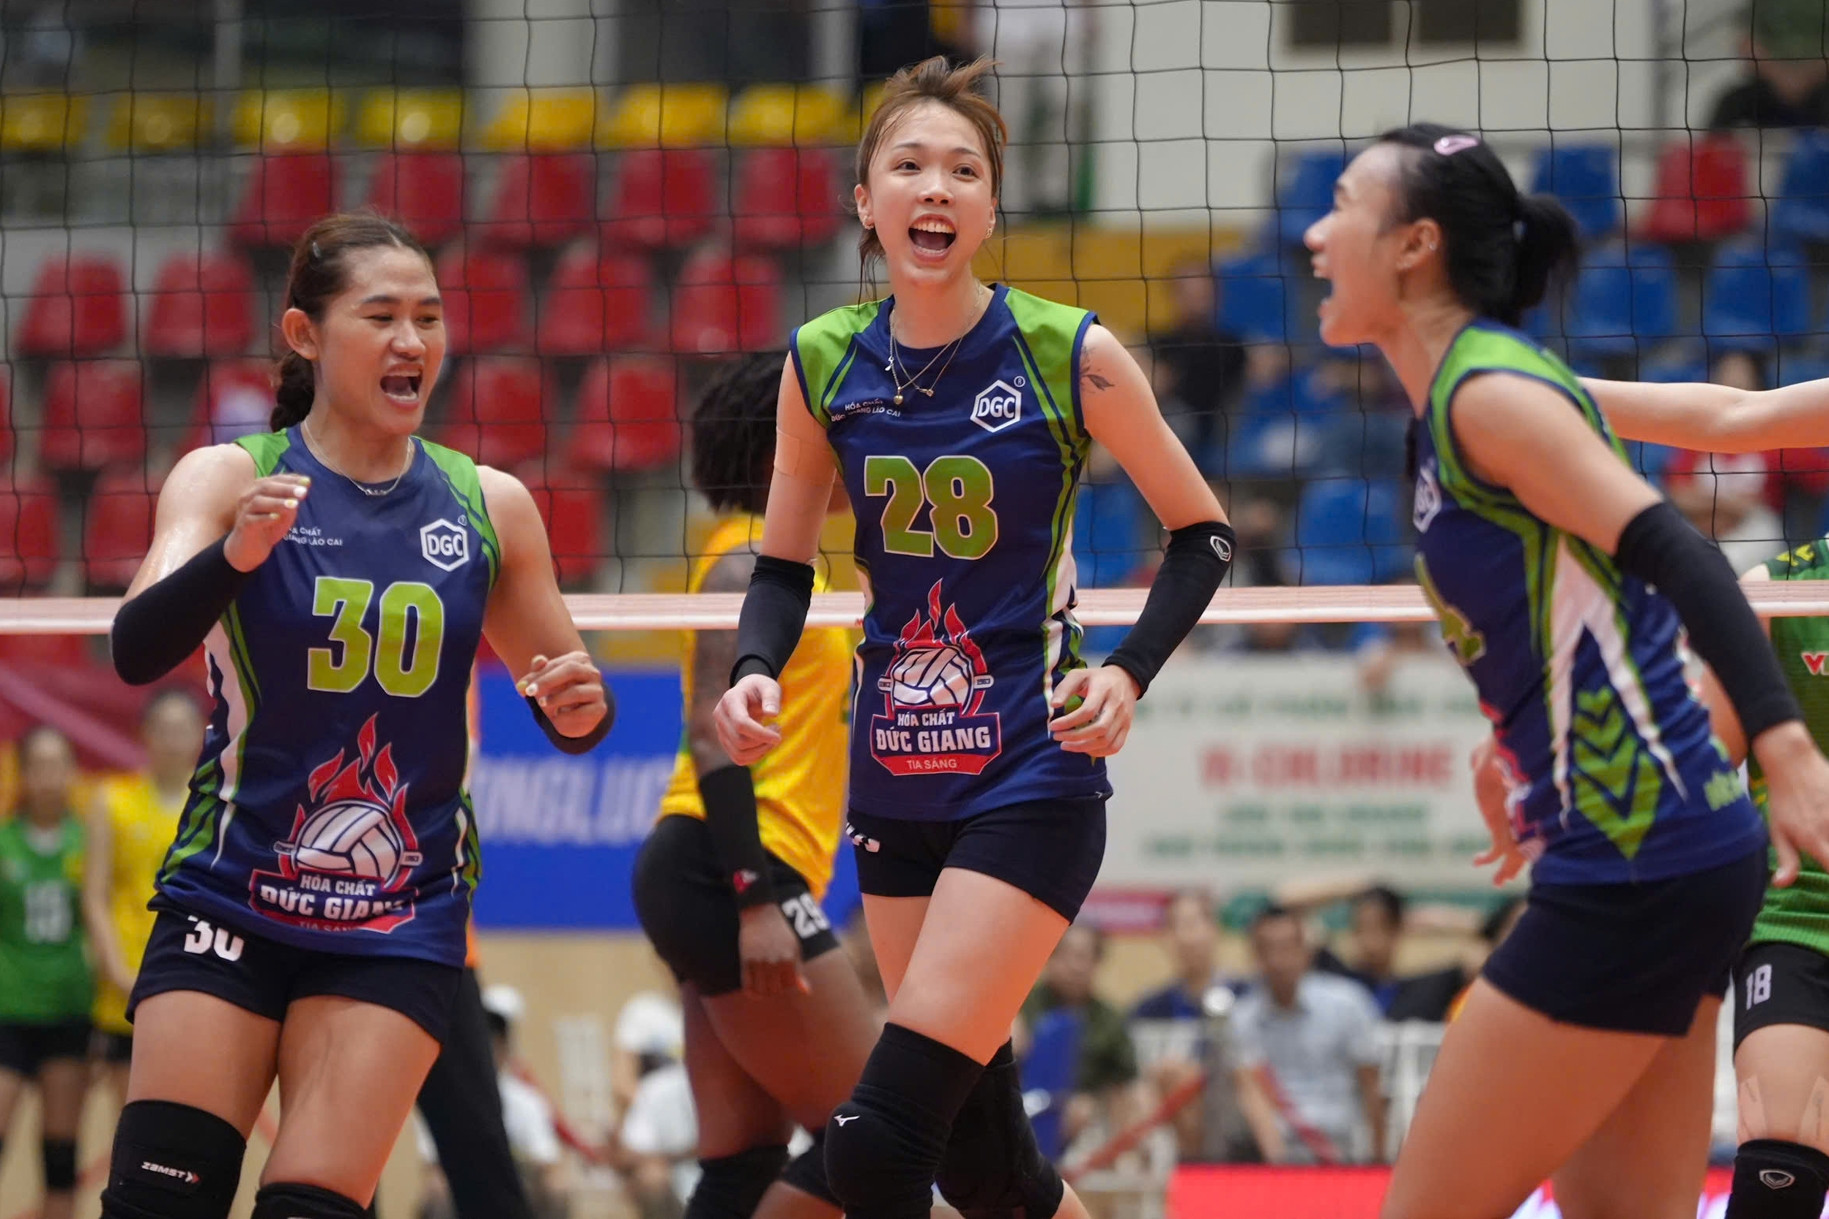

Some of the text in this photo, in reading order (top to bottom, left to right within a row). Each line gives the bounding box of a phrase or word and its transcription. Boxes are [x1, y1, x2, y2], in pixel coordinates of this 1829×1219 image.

[977, 396, 1016, 419] DGC
[864, 455, 999, 560] 28
[326, 538, 343, 546] CAI
[426, 534, 464, 557] DGC
[307, 576, 446, 698] 30
[897, 708, 955, 727] HÓA CHẤT
[876, 726, 991, 753] ĐỨC GIANG
[907, 758, 958, 770] TIA SÁNG
[183, 914, 245, 962] 30
[1745, 963, 1772, 1011] 18
